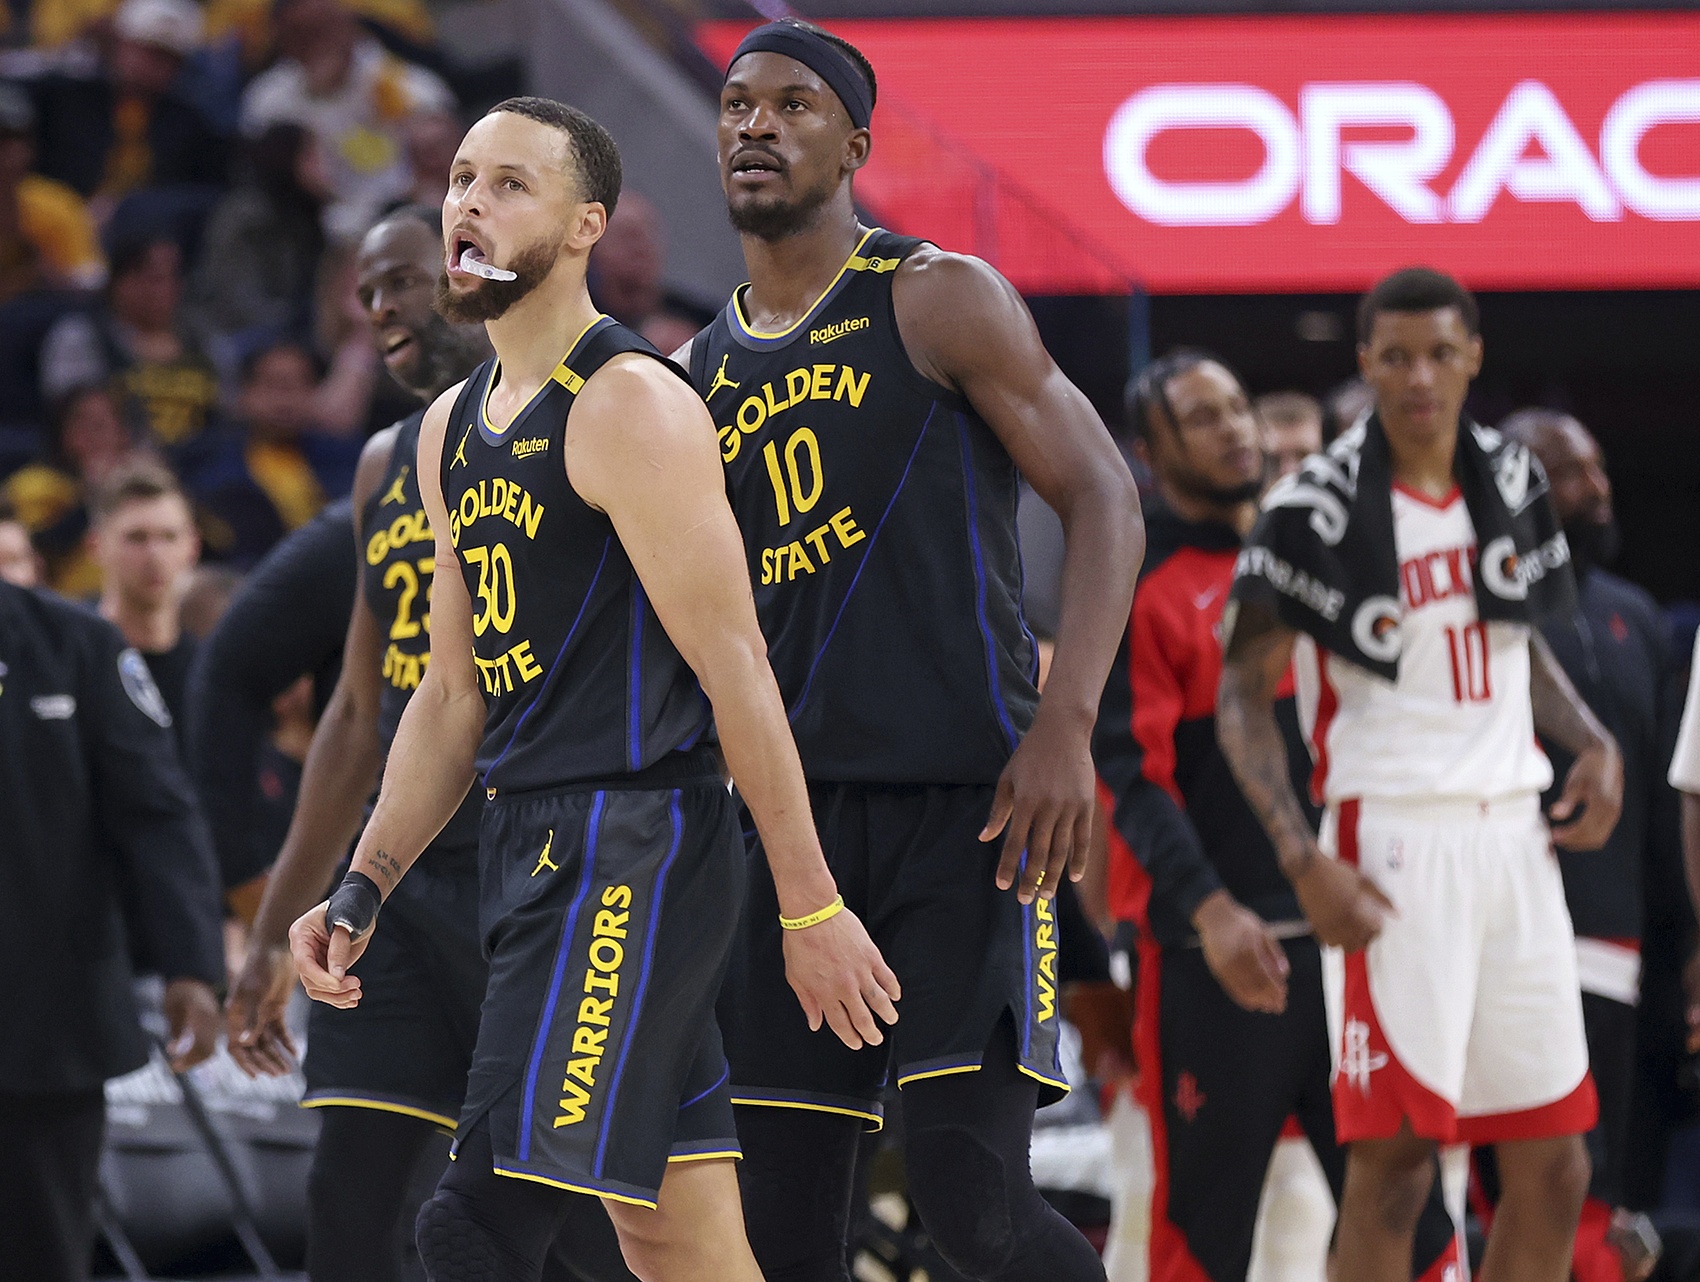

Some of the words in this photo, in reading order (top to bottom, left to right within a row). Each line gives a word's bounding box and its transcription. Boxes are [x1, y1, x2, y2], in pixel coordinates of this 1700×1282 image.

[810, 317, 870, 344] Rakuten
[512, 437, 549, 459] Rakuten
[718, 365, 872, 463] GOLDEN
[451, 478, 545, 548] GOLDEN
[763, 427, 824, 526] 10
[761, 506, 867, 585] STATE
[463, 542, 516, 637] 30
[1445, 621, 1491, 702] 10
[553, 884, 633, 1128] WARRIORS
